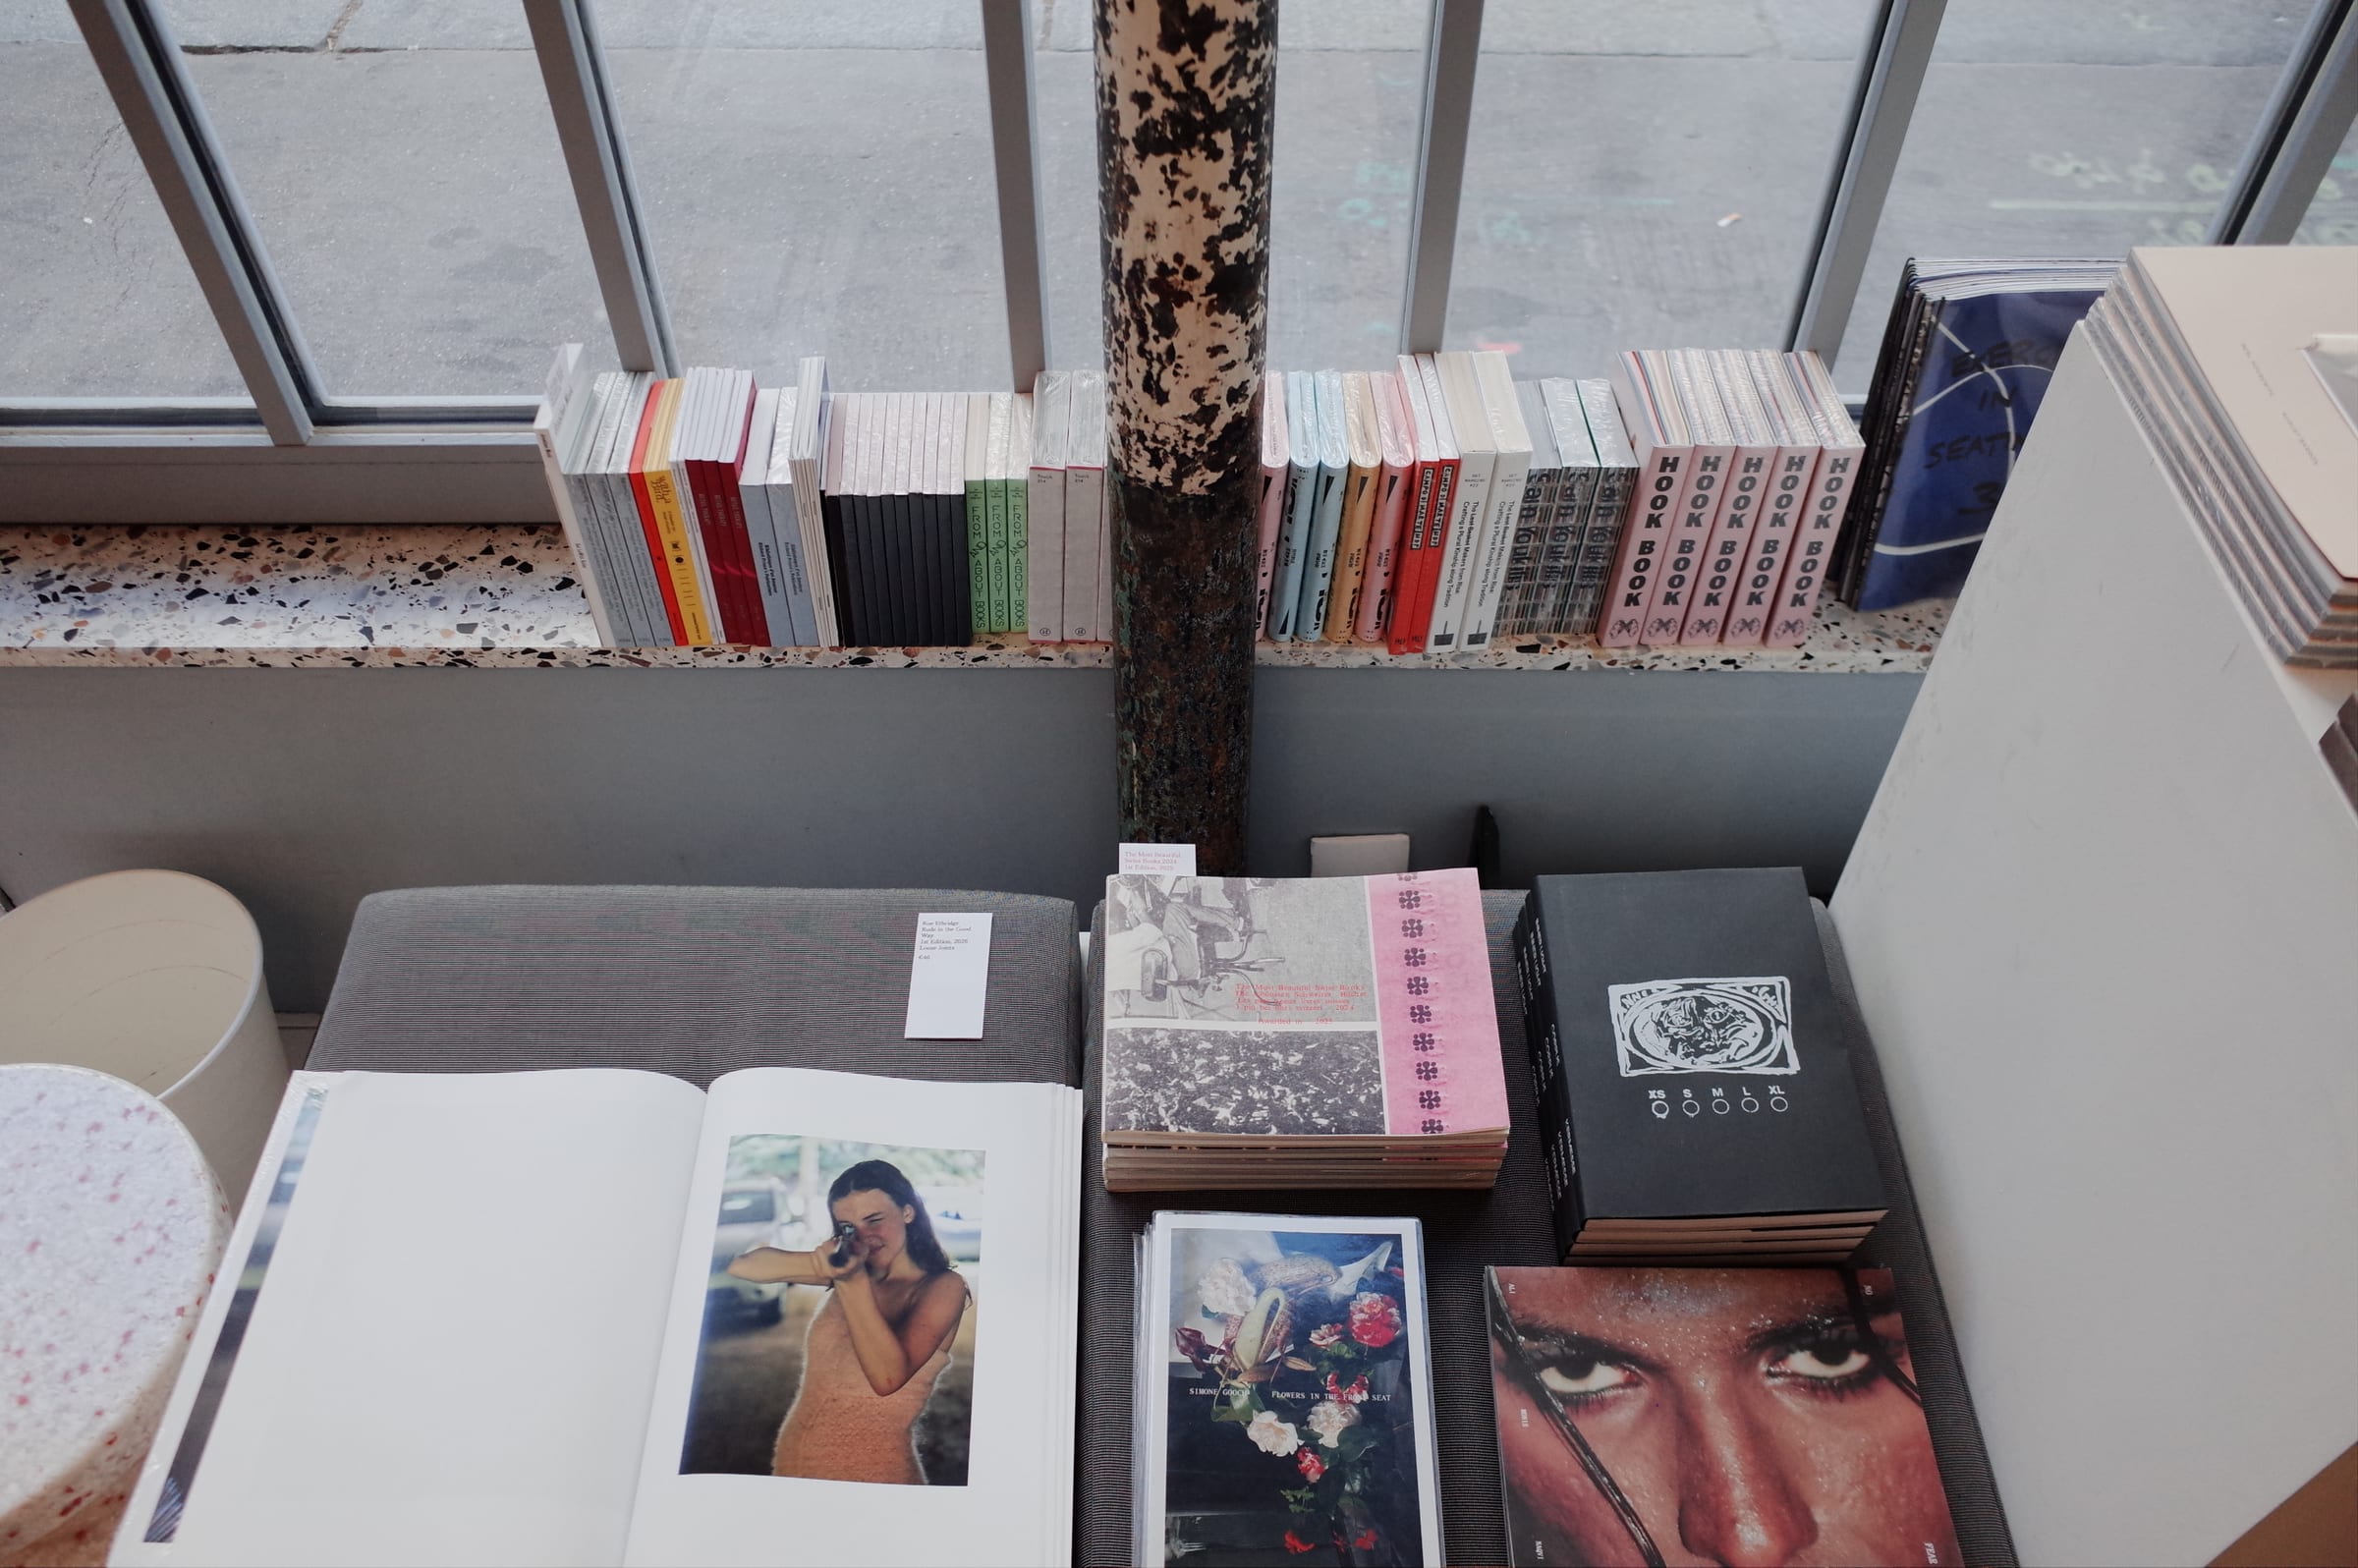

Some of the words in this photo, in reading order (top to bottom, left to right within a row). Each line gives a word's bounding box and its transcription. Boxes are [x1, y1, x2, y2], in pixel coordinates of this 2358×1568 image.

[1421, 470, 1432, 495] CAMPO
[1441, 467, 1450, 492] CAMPO
[1645, 456, 1680, 529] HOOK
[1685, 456, 1721, 528] HOOK
[1727, 457, 1764, 529] HOOK
[1769, 455, 1807, 528] HOOK
[1814, 457, 1851, 530] HOOK
[992, 505, 1001, 537] FROM
[1013, 504, 1022, 537] FROM
[1415, 504, 1427, 530] MARTE
[1433, 501, 1444, 528] MARTE
[1458, 501, 1470, 525] Crafting
[1493, 500, 1505, 525] Crafting
[1455, 530, 1464, 546] Plural
[1490, 530, 1499, 546] Plural
[1450, 547, 1460, 567] Kinship
[1485, 546, 1494, 567] Kinship
[1014, 558, 1023, 596] ABOUT
[1446, 568, 1456, 584] along
[1624, 540, 1656, 607] BOOK
[1662, 539, 1696, 605] BOOK
[1704, 540, 1737, 607] BOOK
[1746, 539, 1780, 606] BOOK
[1790, 540, 1824, 607] BOOK
[1442, 585, 1453, 607] Tradition
[1477, 584, 1488, 606] Tradition
[976, 600, 985, 629] BOOKS
[994, 600, 1004, 627] BOOKS
[1014, 599, 1025, 628] BOOKS
[1649, 1090, 1666, 1098] XS
[1683, 1089, 1692, 1097] S
[1712, 1088, 1723, 1097] M
[1743, 1087, 1751, 1095] L
[1768, 1086, 1785, 1094] XL
[1923, 1541, 1938, 1565] FEAR
